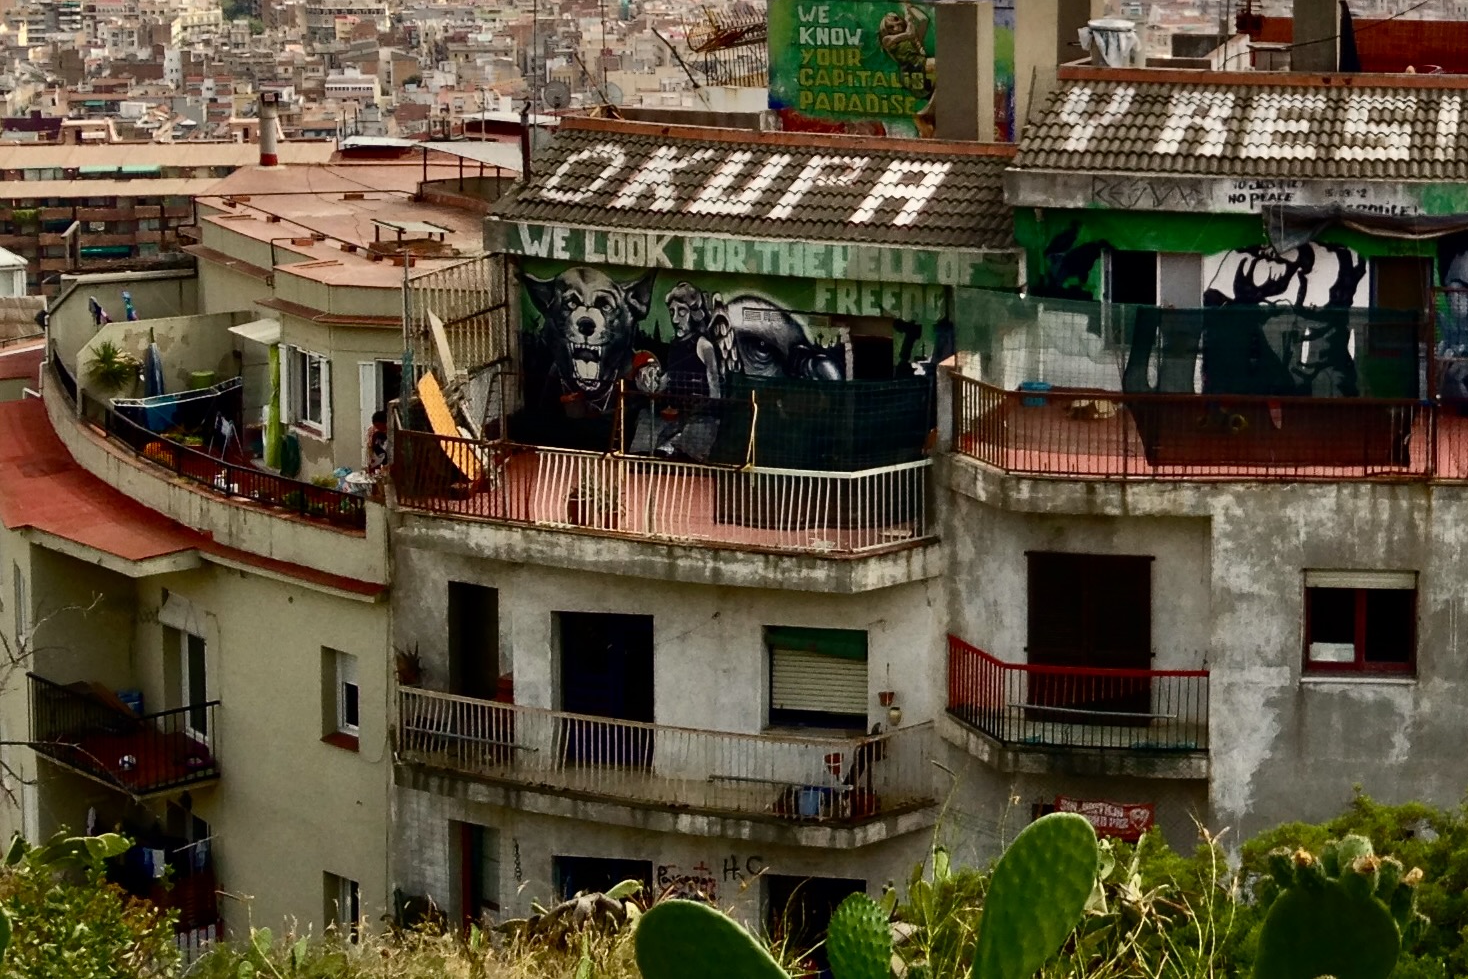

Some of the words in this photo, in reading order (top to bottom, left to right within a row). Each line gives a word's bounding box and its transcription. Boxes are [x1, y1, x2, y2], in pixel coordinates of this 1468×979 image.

[798, 5, 830, 24] WE
[799, 26, 863, 46] KNOW
[800, 48, 861, 67] YOUR
[1060, 86, 1135, 153] Y
[537, 141, 952, 227] OKUPA
[1228, 193, 1246, 204] NO
[1249, 192, 1295, 210] PEACE
[584, 229, 674, 269] LOOK
[683, 236, 750, 274] FOR
[754, 241, 827, 279] THE
[832, 243, 924, 284] HELL
[936, 249, 984, 286] OF
